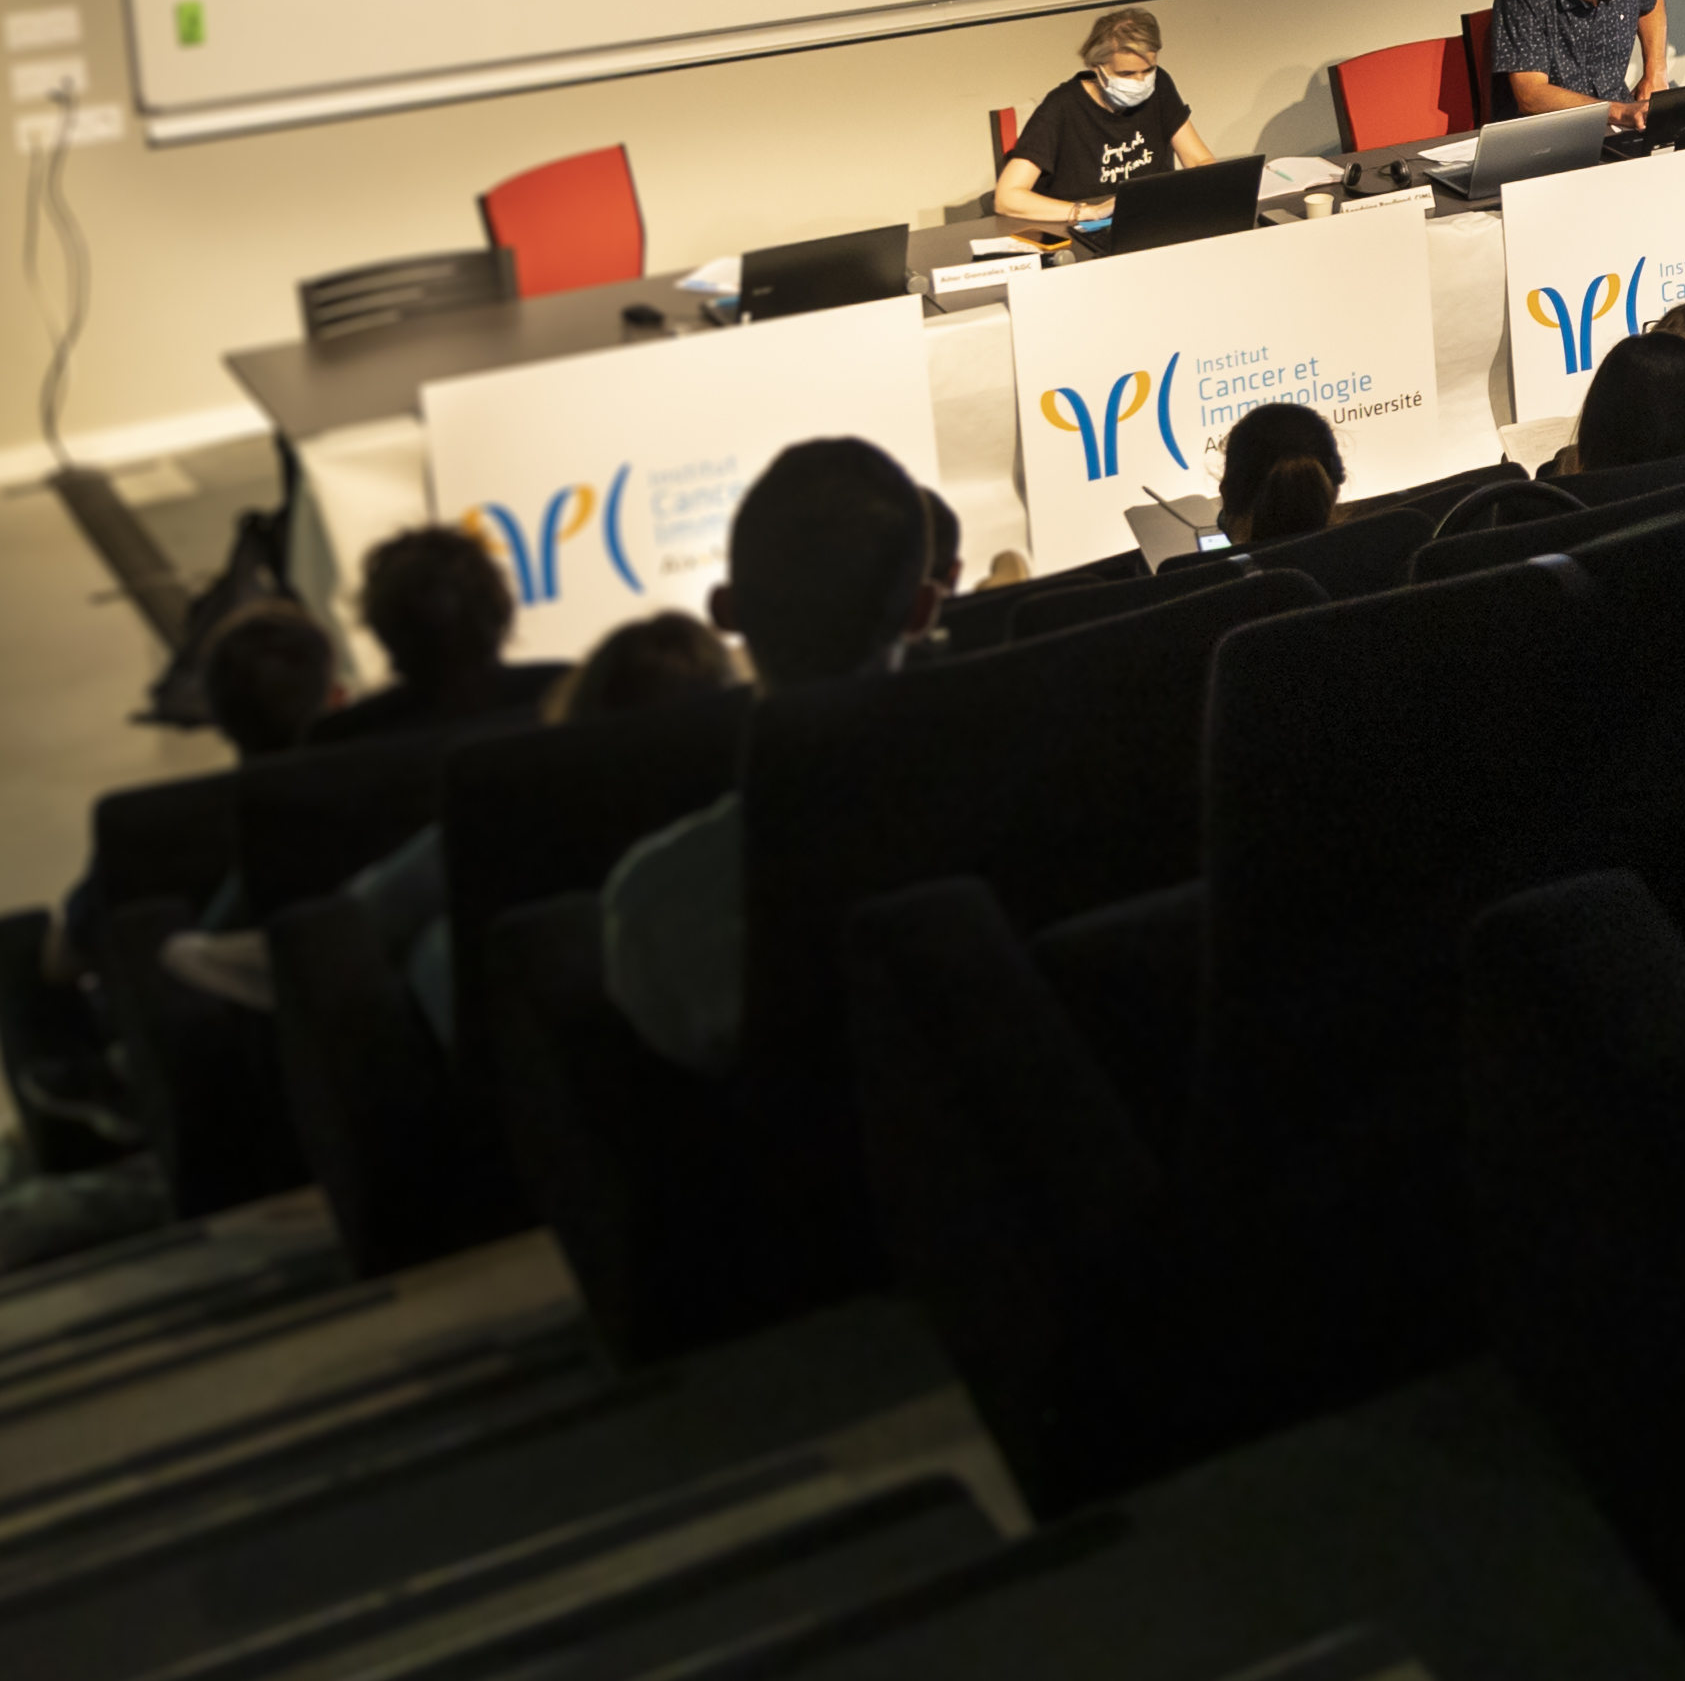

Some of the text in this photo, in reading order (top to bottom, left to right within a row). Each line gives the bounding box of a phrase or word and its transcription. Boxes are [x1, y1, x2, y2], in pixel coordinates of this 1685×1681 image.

[1196, 346, 1270, 375] Institut
[1198, 357, 1320, 401] Cancer et
[1333, 391, 1423, 424] Université
